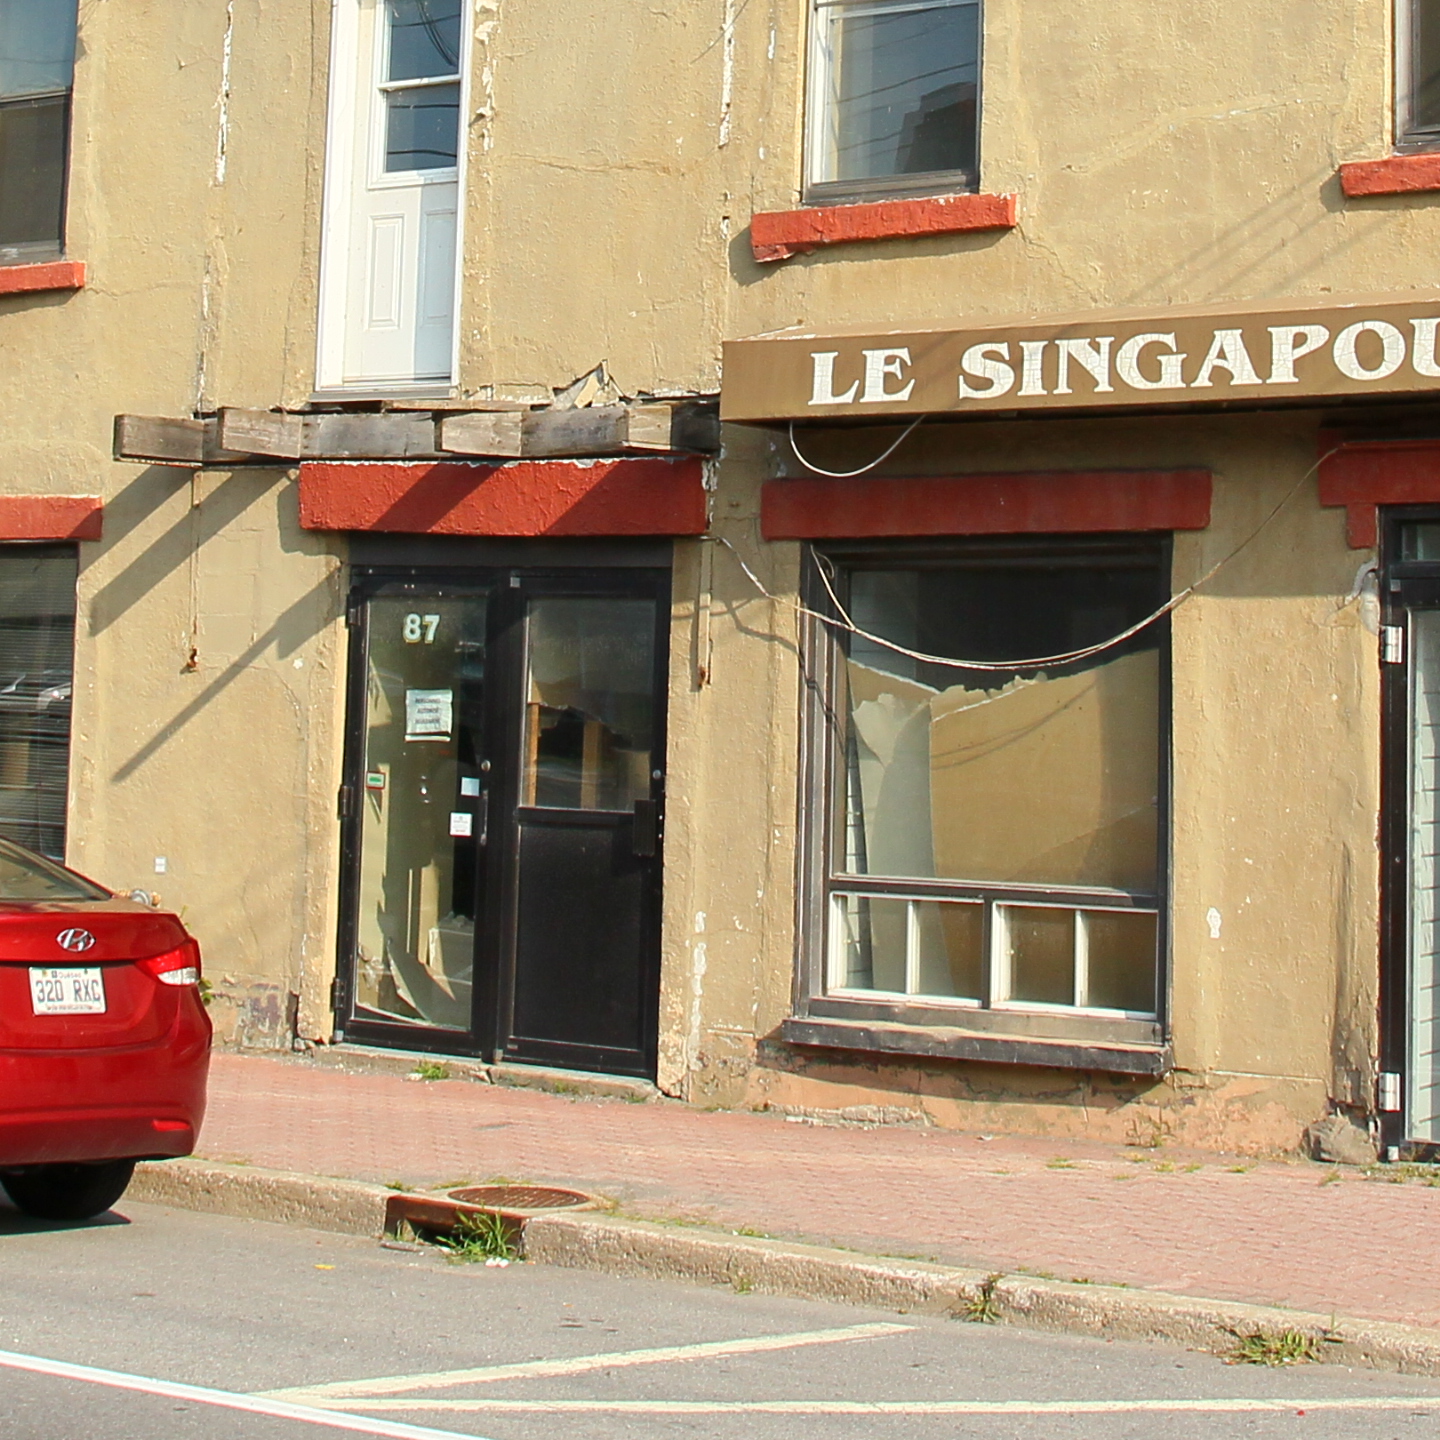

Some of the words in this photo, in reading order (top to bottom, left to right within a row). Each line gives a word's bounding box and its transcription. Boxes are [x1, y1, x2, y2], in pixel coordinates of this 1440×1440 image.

[808, 347, 915, 405] LE
[403, 613, 440, 644] 87
[35, 979, 64, 1002] 320
[72, 978, 101, 1003] RXC
